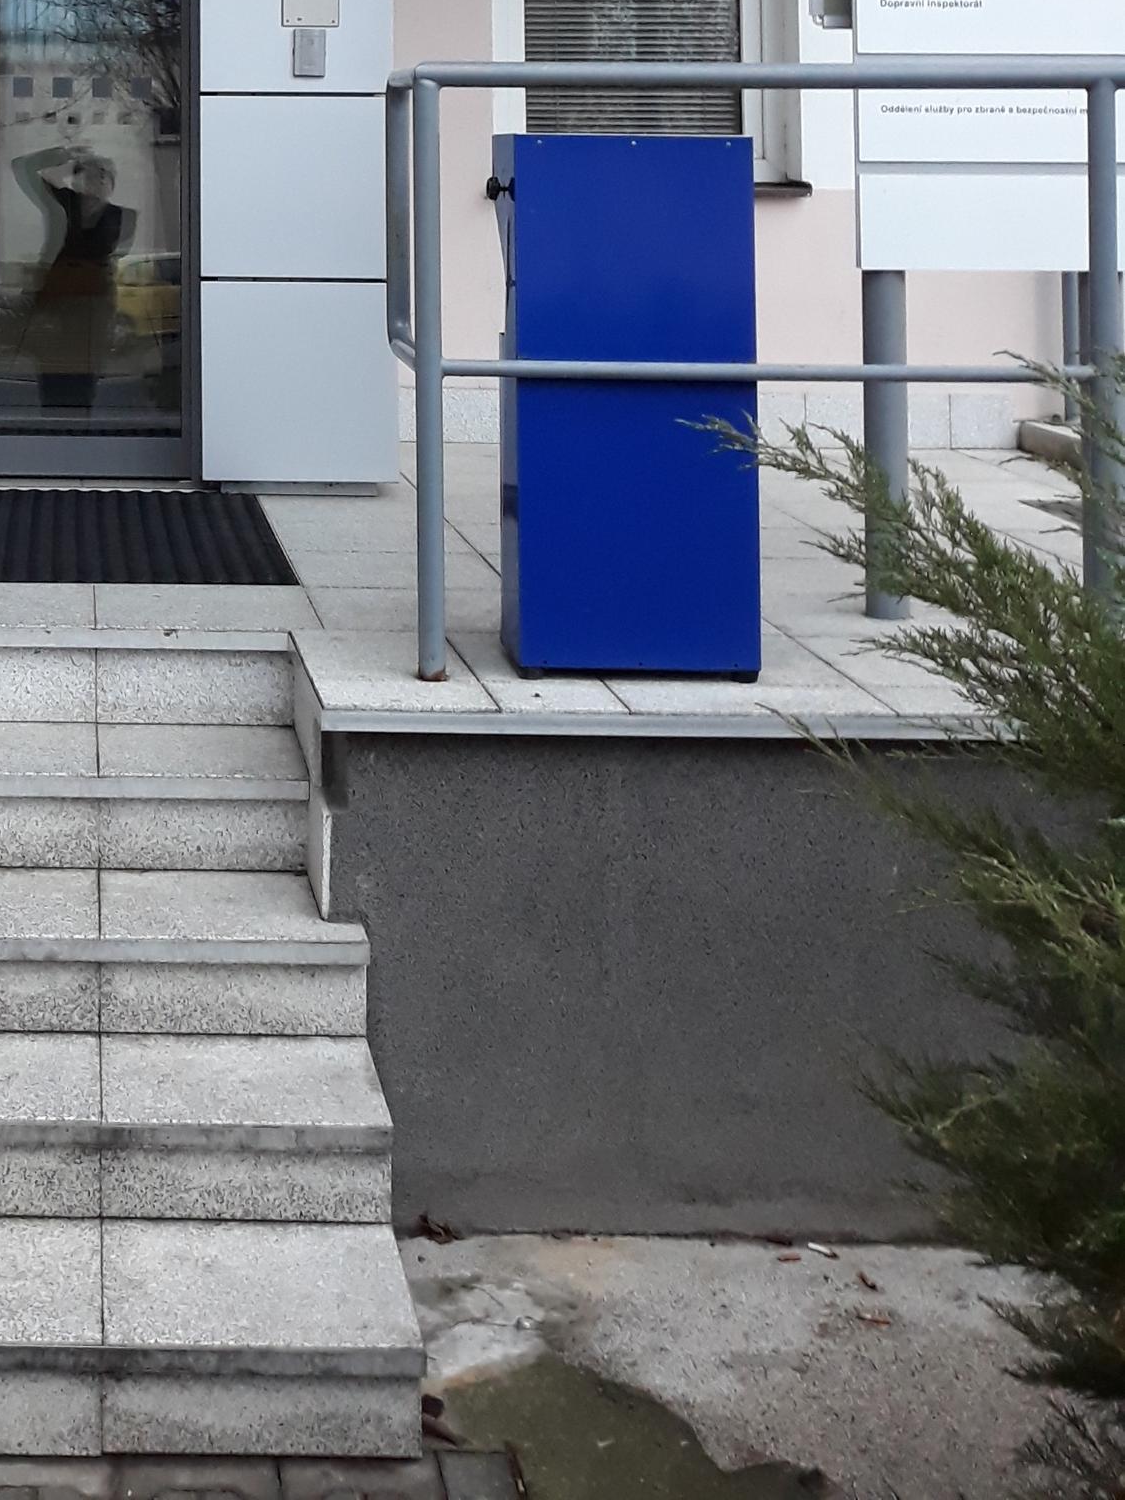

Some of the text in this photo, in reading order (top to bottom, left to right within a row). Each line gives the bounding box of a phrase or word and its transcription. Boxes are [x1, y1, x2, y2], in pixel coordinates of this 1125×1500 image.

[880, 104, 922, 114] Oddělení
[925, 104, 954, 115] služby
[957, 106, 972, 115] pro
[975, 105, 1005, 114] zbraně
[1016, 105, 1077, 115] bezpečnostní
